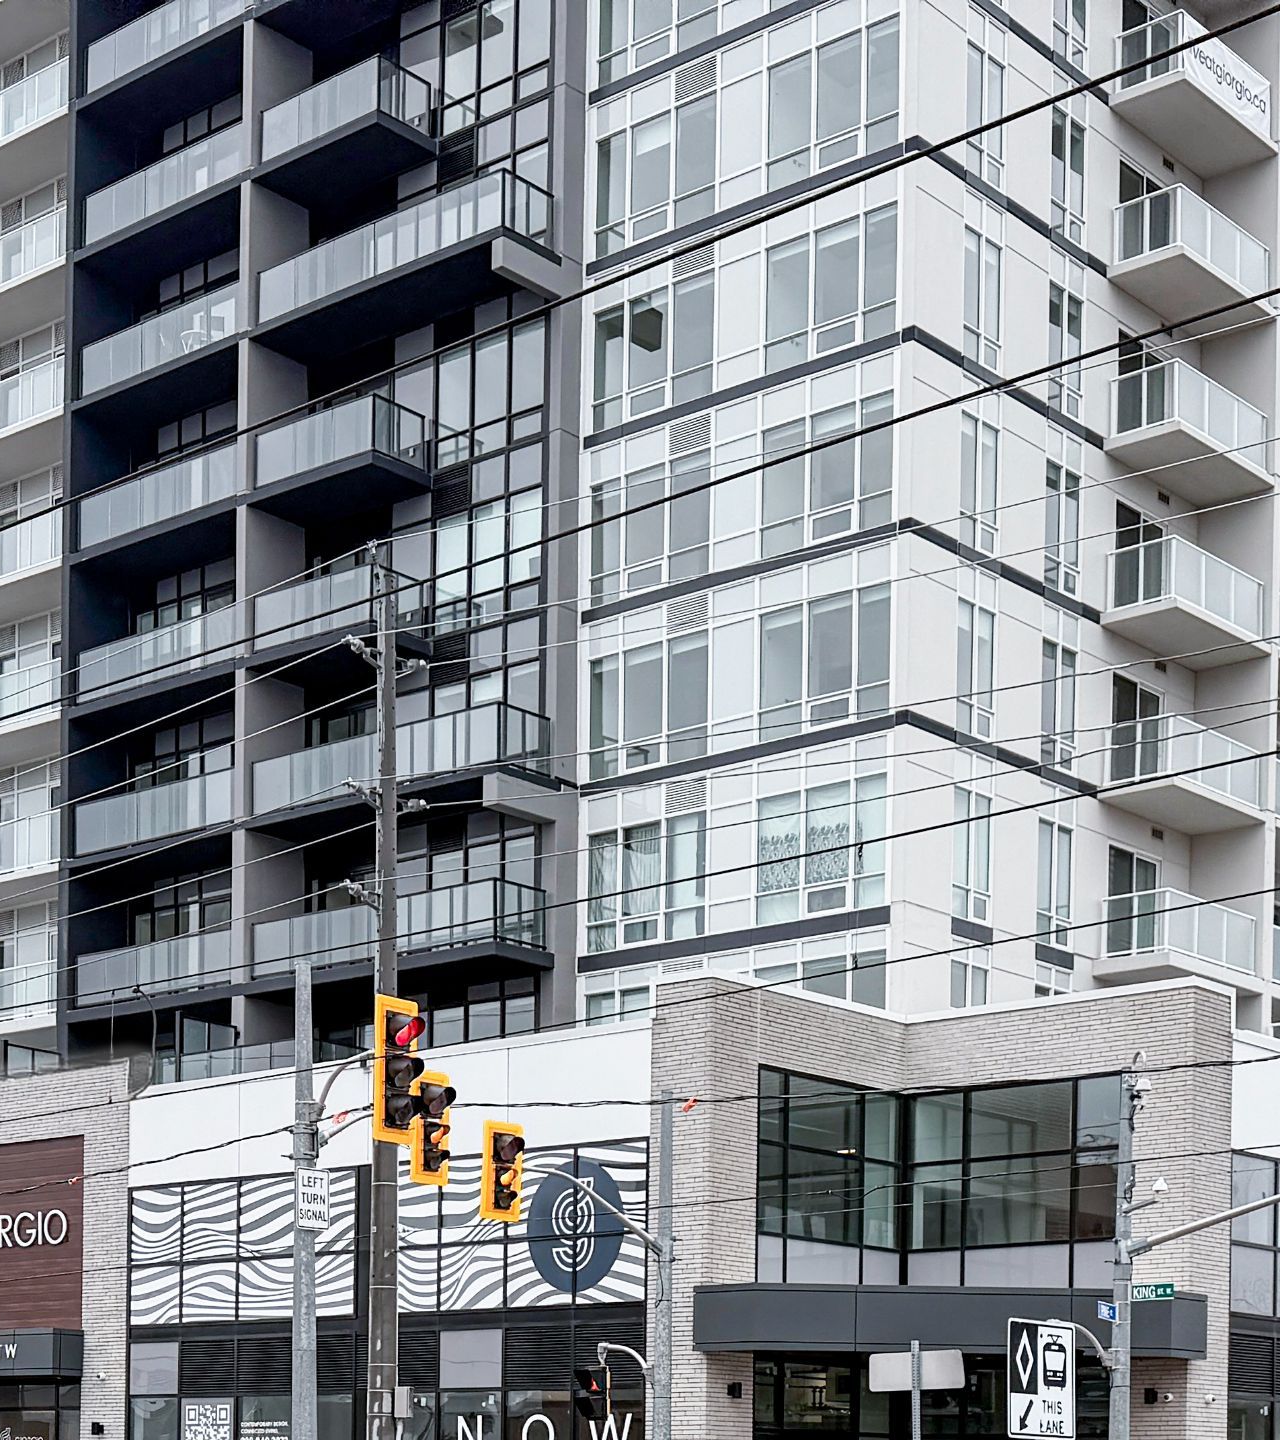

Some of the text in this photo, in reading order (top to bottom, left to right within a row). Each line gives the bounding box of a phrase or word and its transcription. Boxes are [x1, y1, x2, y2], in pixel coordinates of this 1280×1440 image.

[302, 1175, 324, 1189] LEFT
[301, 1192, 325, 1205] TURN
[299, 1208, 328, 1222] SIGNAL
[1132, 1286, 1156, 1299] KING
[5, 1343, 17, 1359] W
[1042, 1400, 1063, 1415] THIS
[1039, 1420, 1065, 1435] LANE
